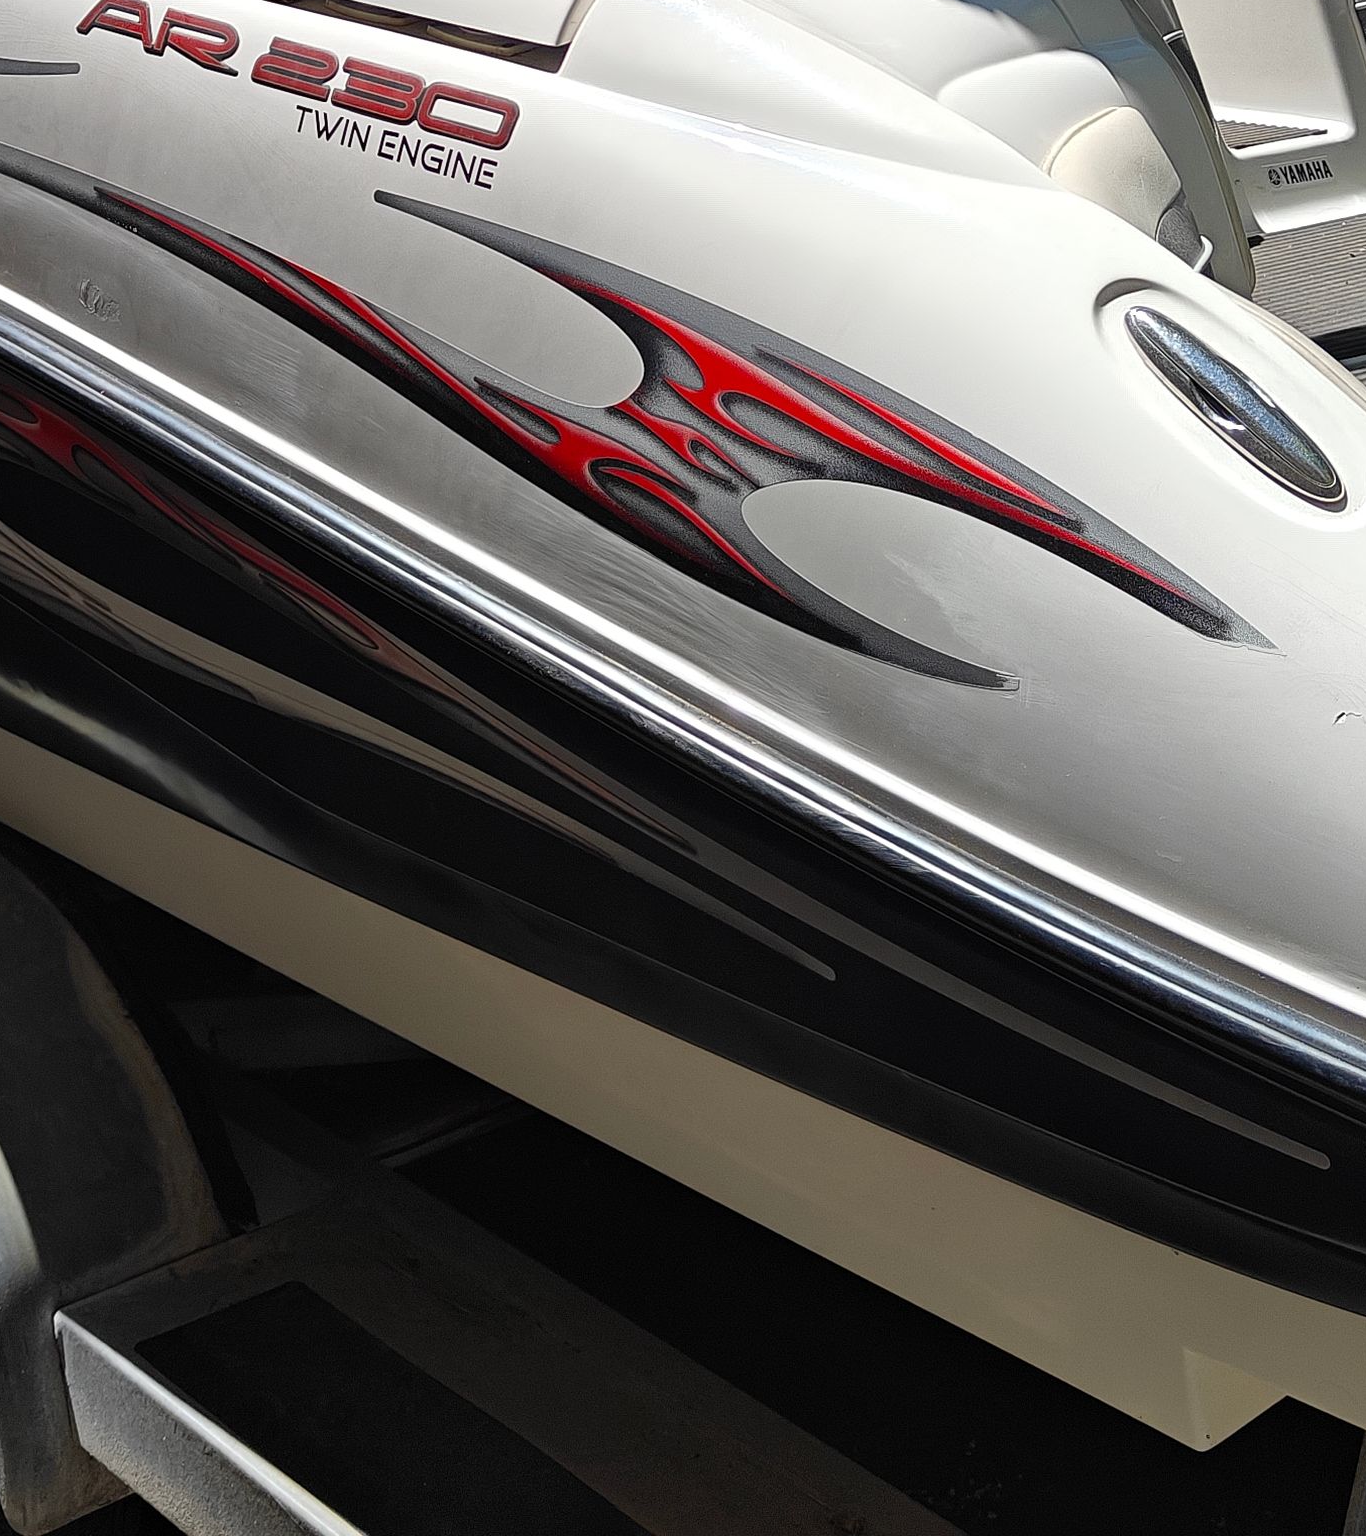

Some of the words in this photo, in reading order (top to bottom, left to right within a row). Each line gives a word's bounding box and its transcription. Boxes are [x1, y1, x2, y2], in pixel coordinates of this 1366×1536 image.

[251, 36, 520, 151] 230
[296, 105, 371, 154] TWIN
[377, 132, 498, 190] ENGINE
[1279, 160, 1334, 184] YAMAHA
